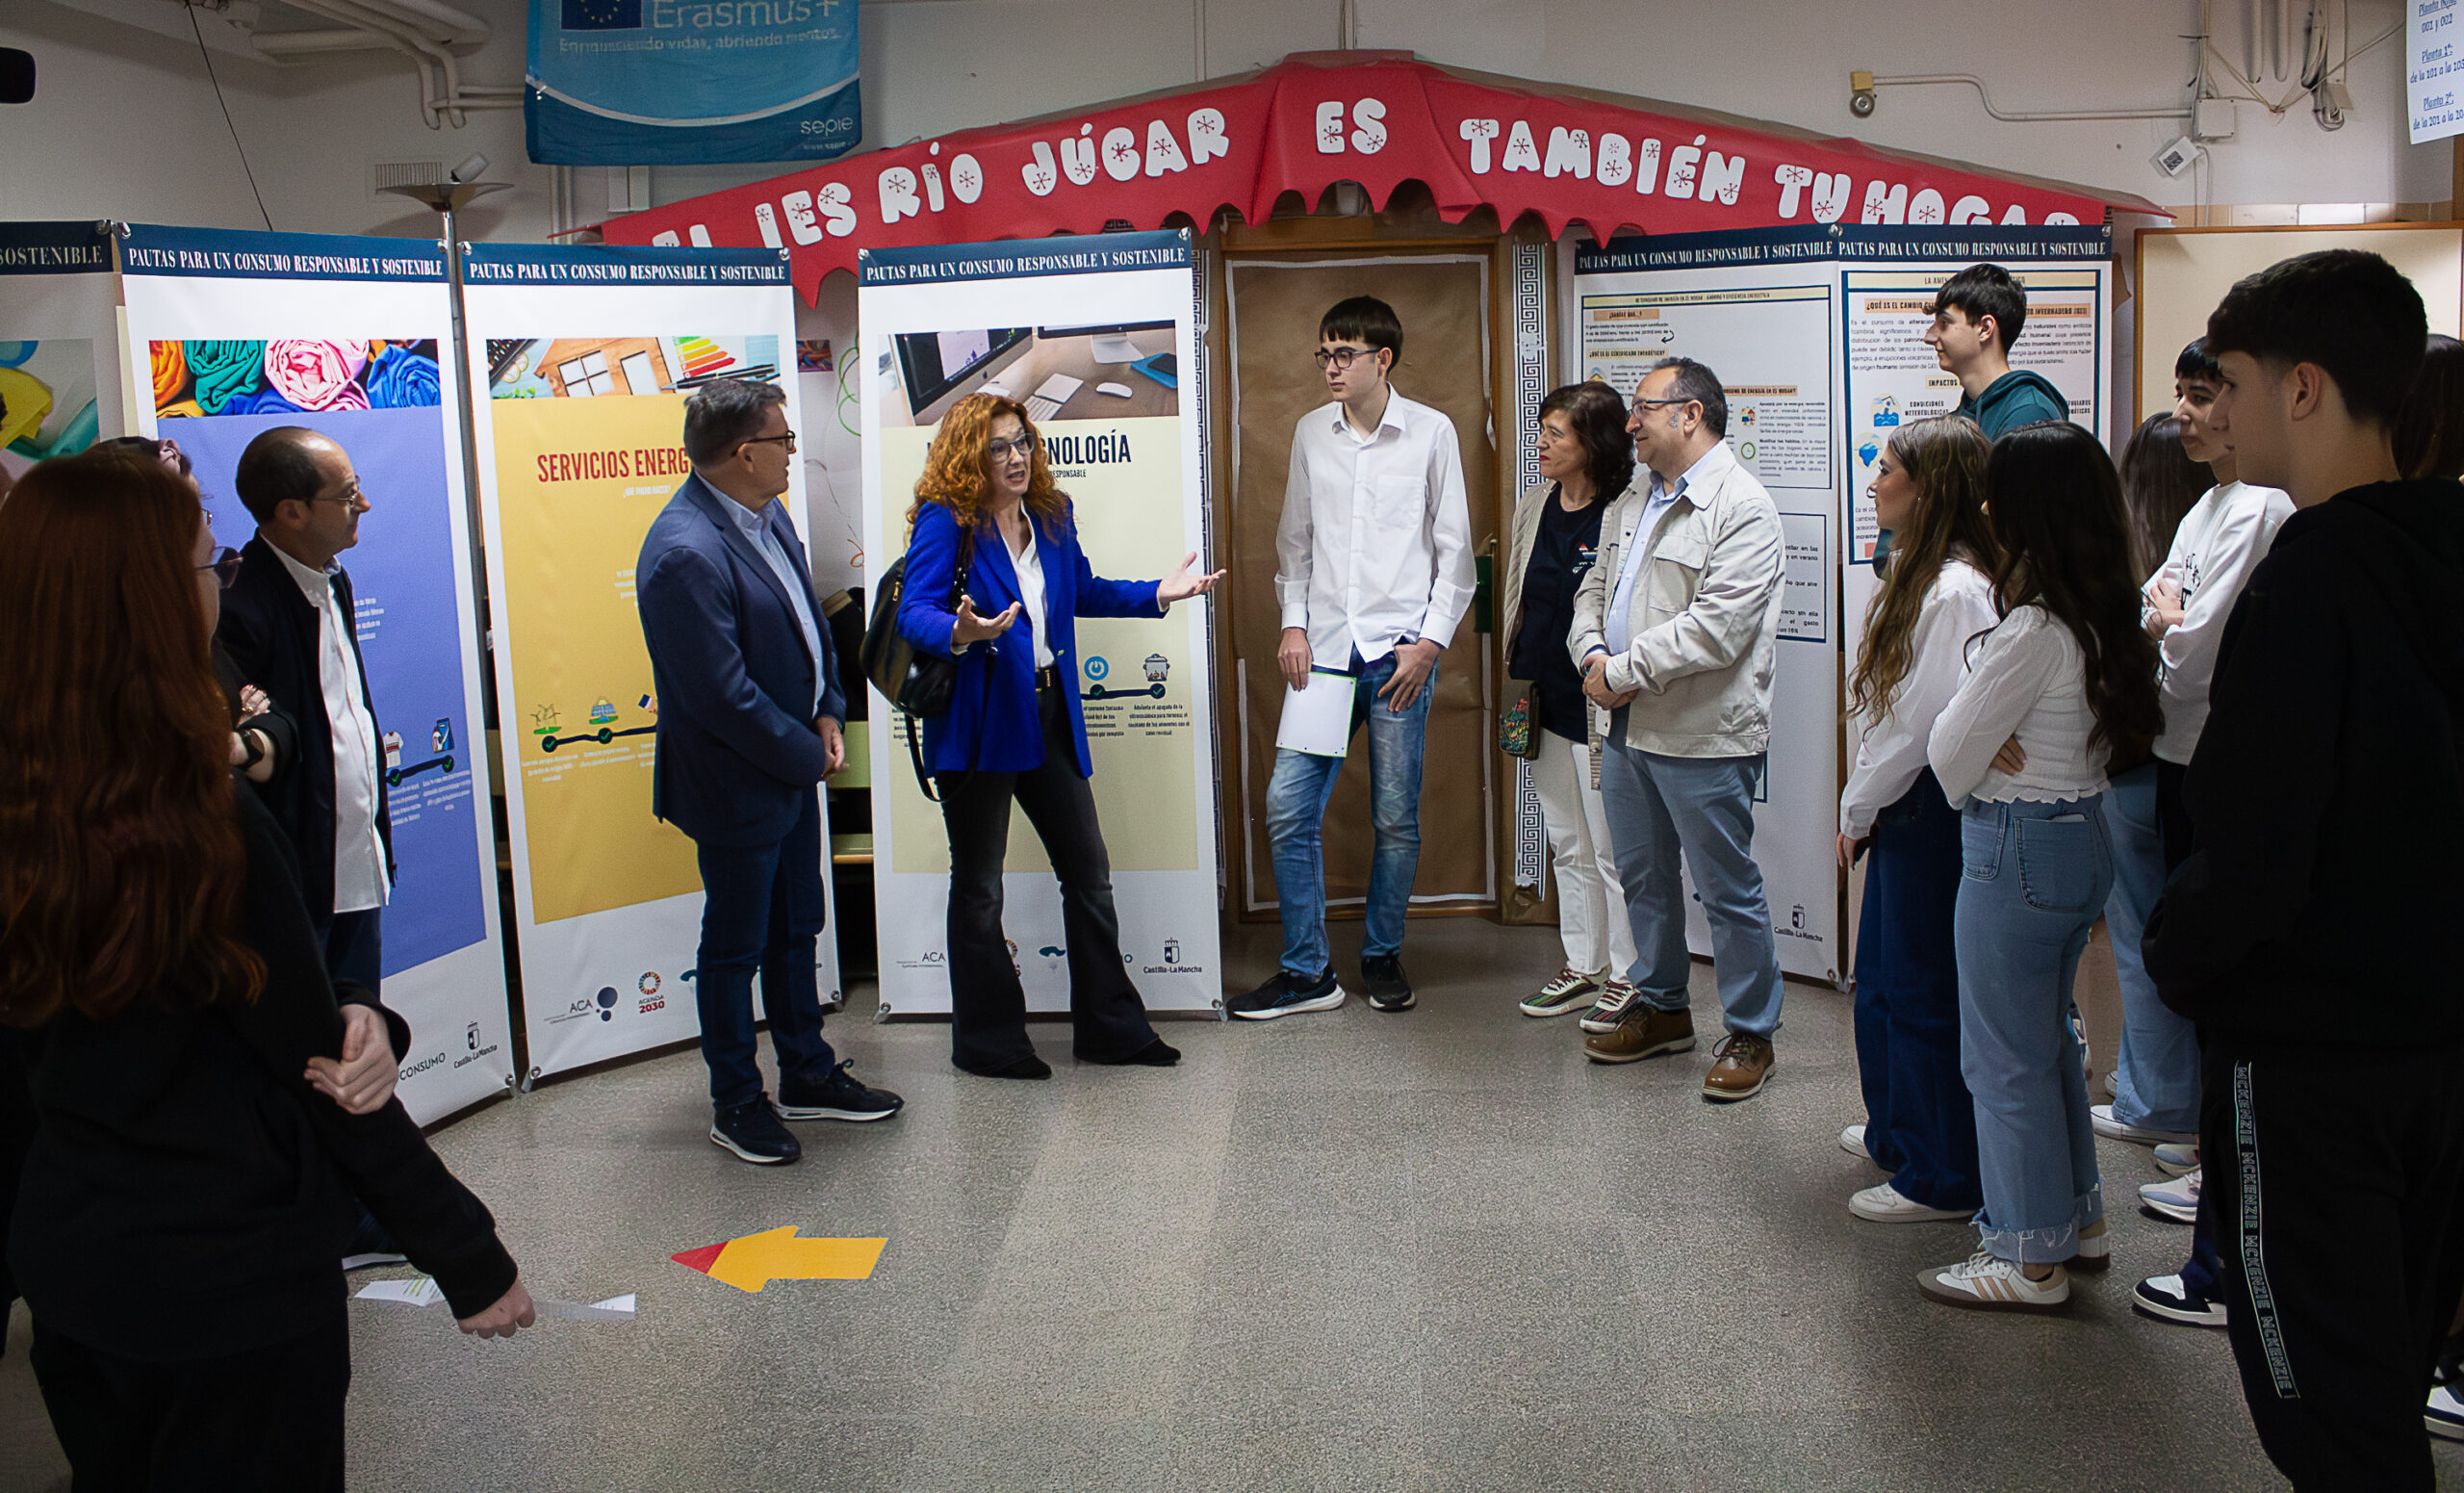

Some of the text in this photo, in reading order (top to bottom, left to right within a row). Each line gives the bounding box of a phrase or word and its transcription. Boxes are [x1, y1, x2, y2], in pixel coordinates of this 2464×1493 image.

[654, 0, 839, 29] Erasmus+
[800, 116, 854, 138] sepie
[755, 182, 857, 247] IES
[879, 142, 984, 223] RÍO
[1021, 122, 1230, 196] JÚGAR
[1315, 98, 1388, 155] ES
[1458, 118, 1746, 205] TAMBIÉN
[1774, 165, 1852, 223] TU
[129, 247, 443, 276] PAUTAS PARA UN CONSUMO RESPONSABLE Y SOSTENIBLE
[1579, 241, 1833, 270] PAUTAS PARA UN CONSUMO RESPONSABLE Y SOSTENIBLE
[1838, 242, 2106, 256] PAUTAS PARA UN CONSUMO RESPONSABLE Y SOSTENIBLE
[470, 263, 785, 280] PAUTAS PARA UN CONSUMO RESPONSABLE Y SOSTENIBLE
[866, 247, 1186, 281] PAUTAS PARA UN CONSUMO RESPONSABLE Y SOSTENIBLE
[1866, 300, 1883, 310] ¿QUÉ
[1928, 378, 1958, 387] IMPACTOS
[536, 450, 629, 483] SERVICIOS
[921, 951, 946, 963] ACA
[570, 998, 593, 1014] ACA
[639, 1000, 665, 1015] 2030
[399, 1052, 447, 1081] CONSUMO
[2237, 1066, 2253, 1145] MCKENZIE
[2241, 1151, 2259, 1230] MCKENZIE
[2245, 1234, 2272, 1310] MCKENZIE
[2260, 1315, 2293, 1390] MCKENZIE
